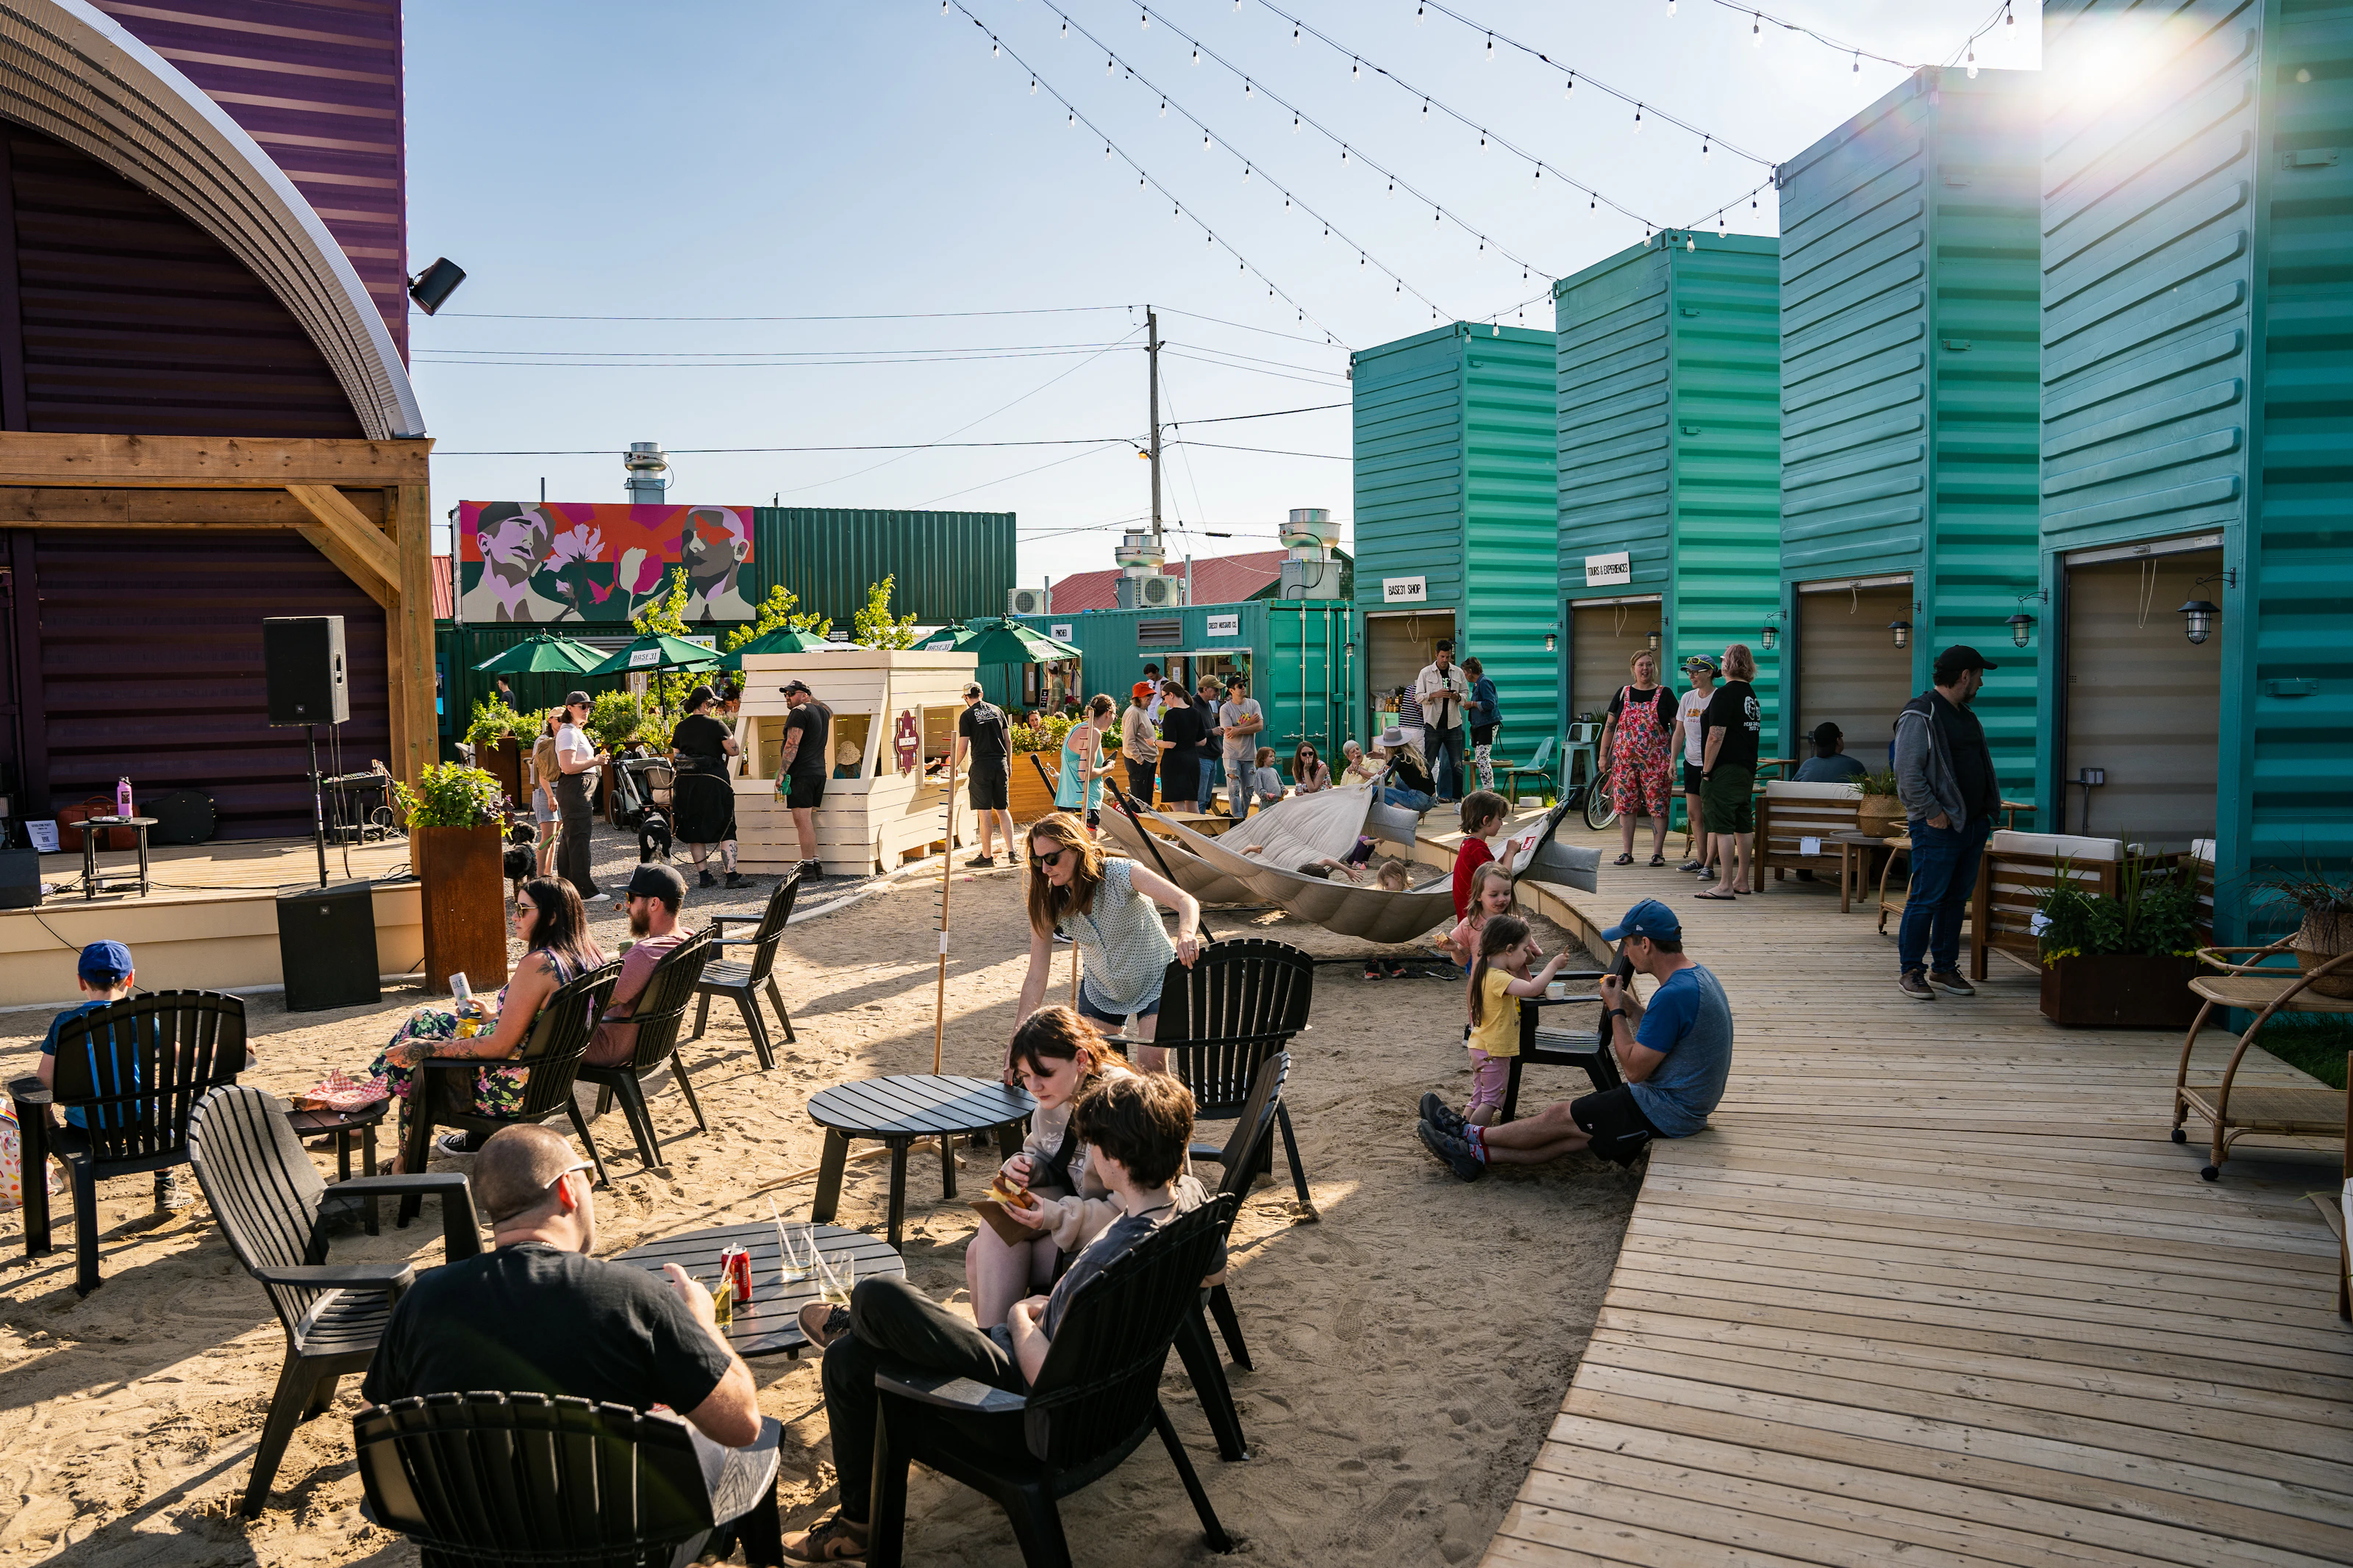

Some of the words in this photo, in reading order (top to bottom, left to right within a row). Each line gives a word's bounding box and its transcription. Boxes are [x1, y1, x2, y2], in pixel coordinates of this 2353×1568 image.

[1588, 566, 1599, 576] TOURS
[1604, 563, 1628, 574] EXPERIENCES
[1388, 584, 1405, 595] BASE31
[1407, 584, 1421, 595] SHOP
